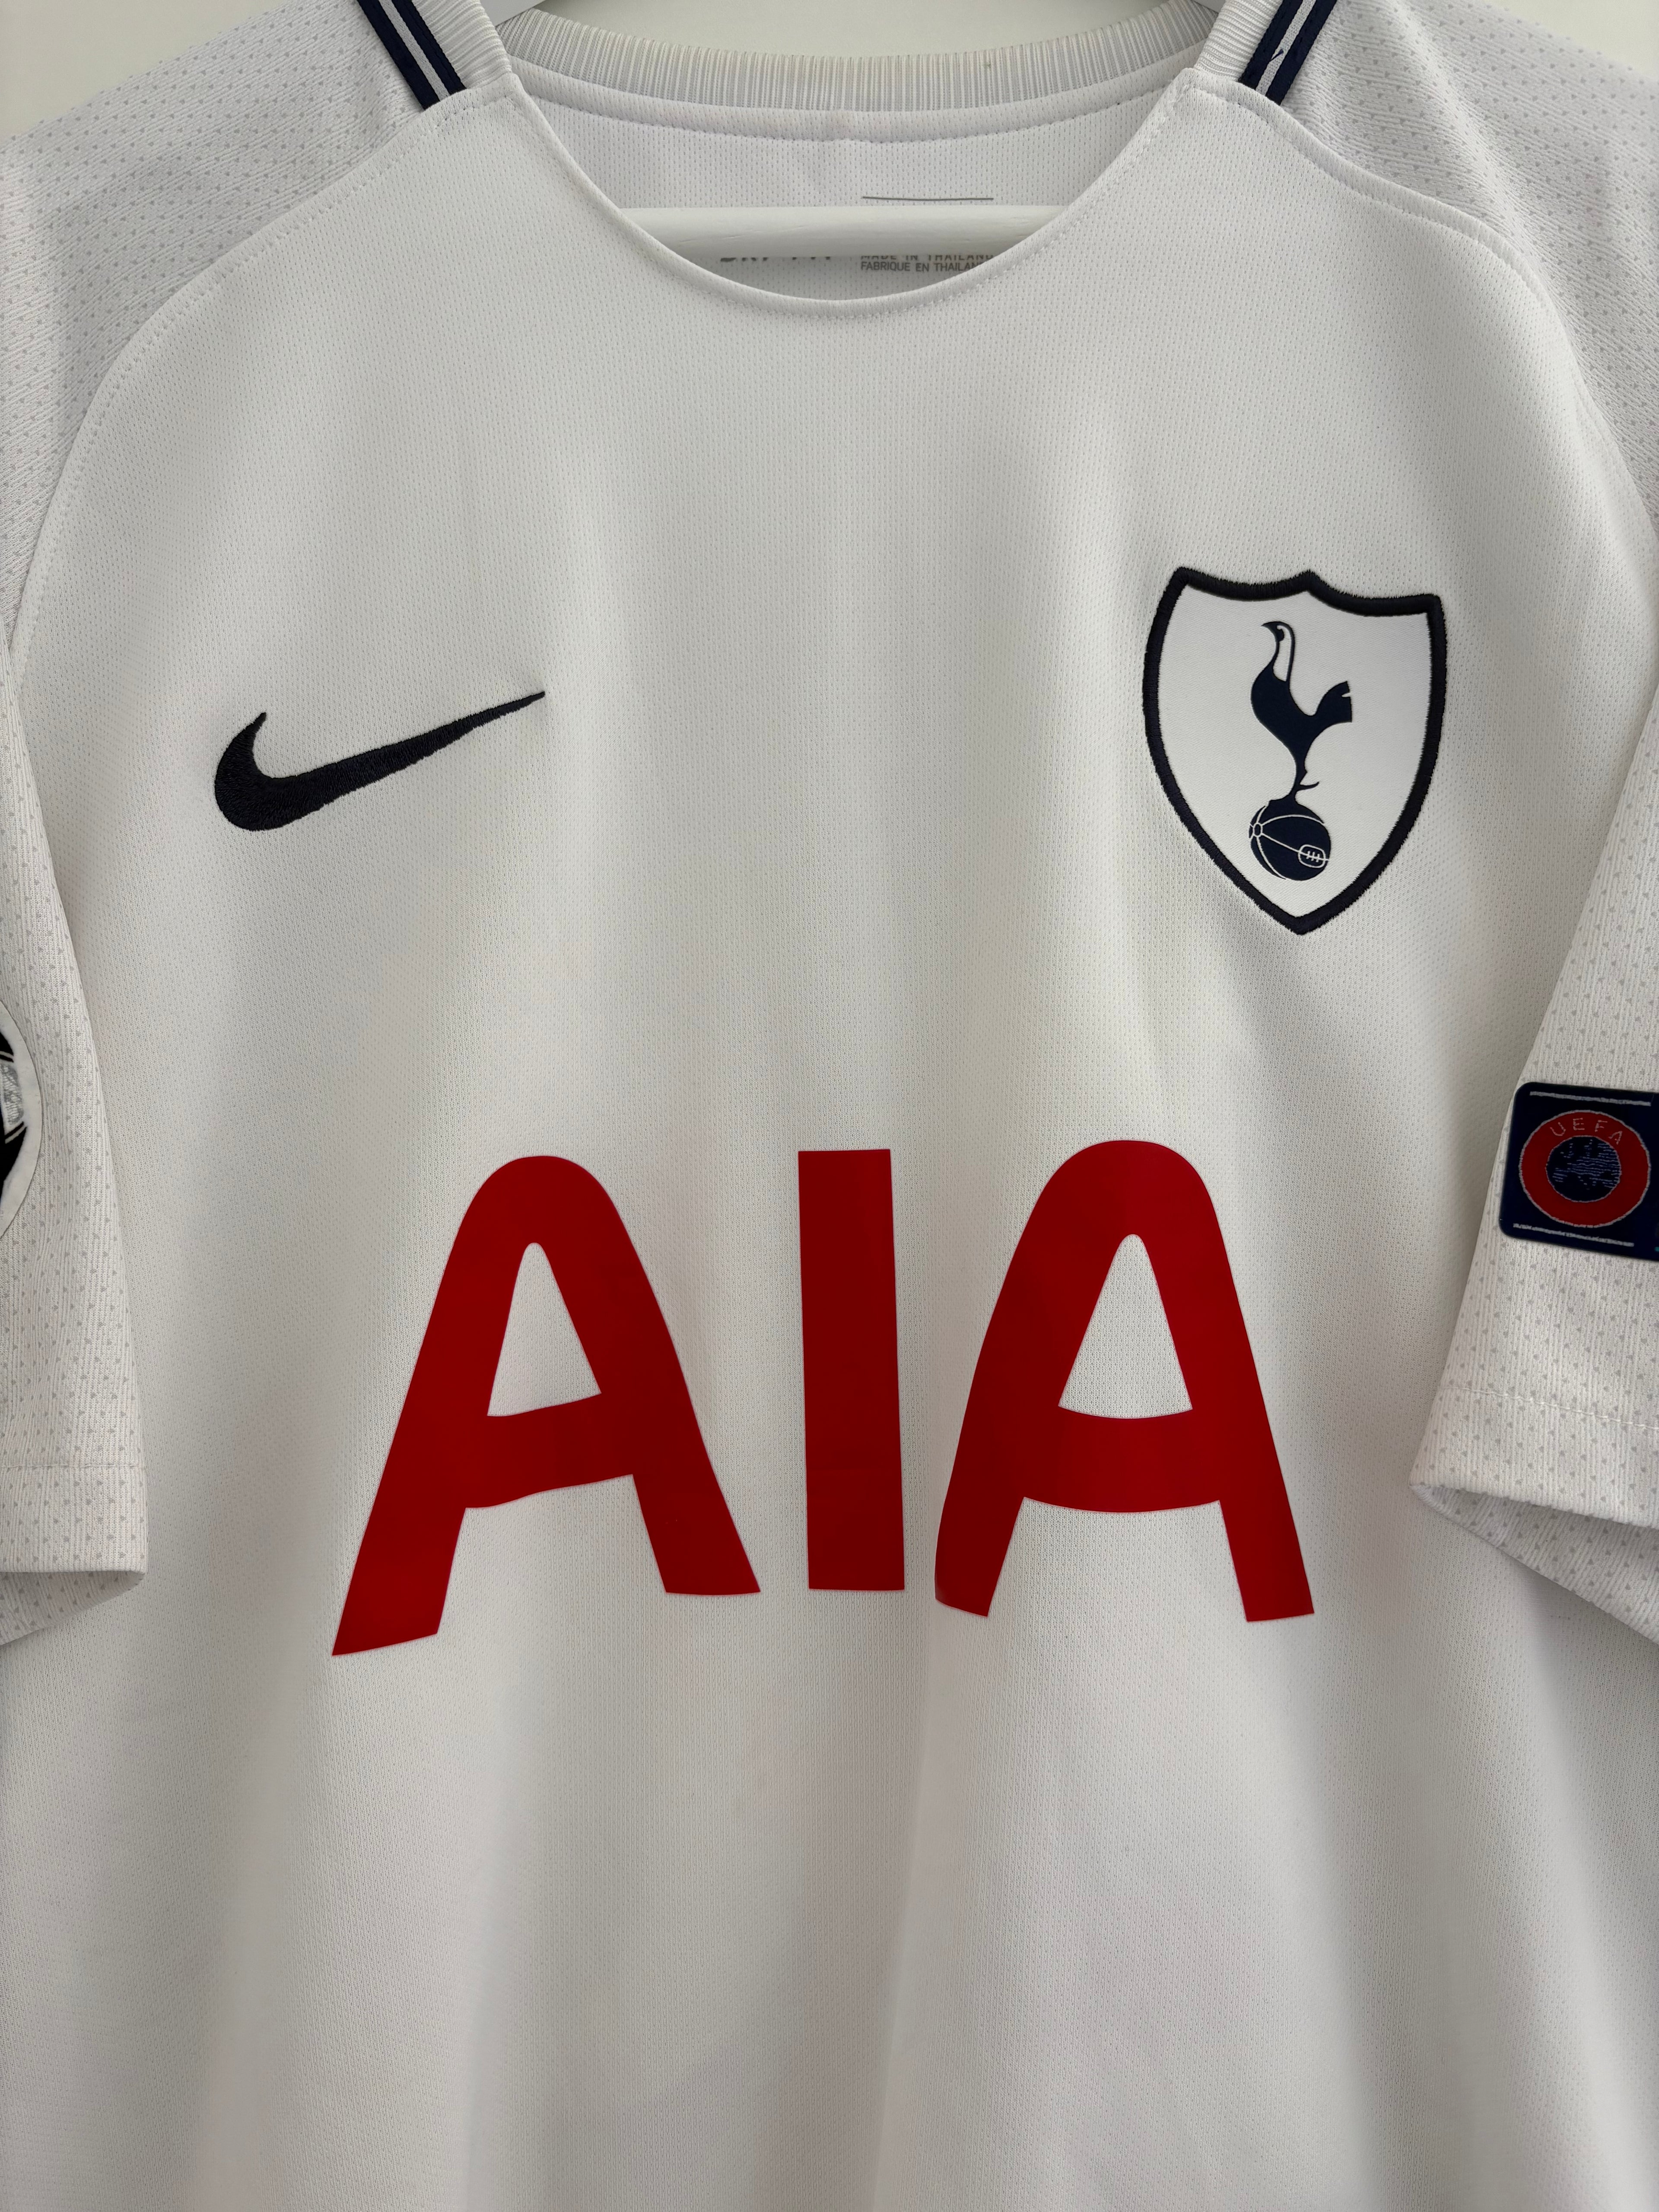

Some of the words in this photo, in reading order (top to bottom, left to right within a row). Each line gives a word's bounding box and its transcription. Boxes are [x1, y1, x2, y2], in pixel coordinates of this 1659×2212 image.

[861, 261, 910, 271] FABRIQUE
[915, 263, 929, 272] EN
[934, 262, 982, 272] THAILAN
[1550, 1117, 1623, 1145] UEFA
[332, 1140, 1313, 1656] AIA
